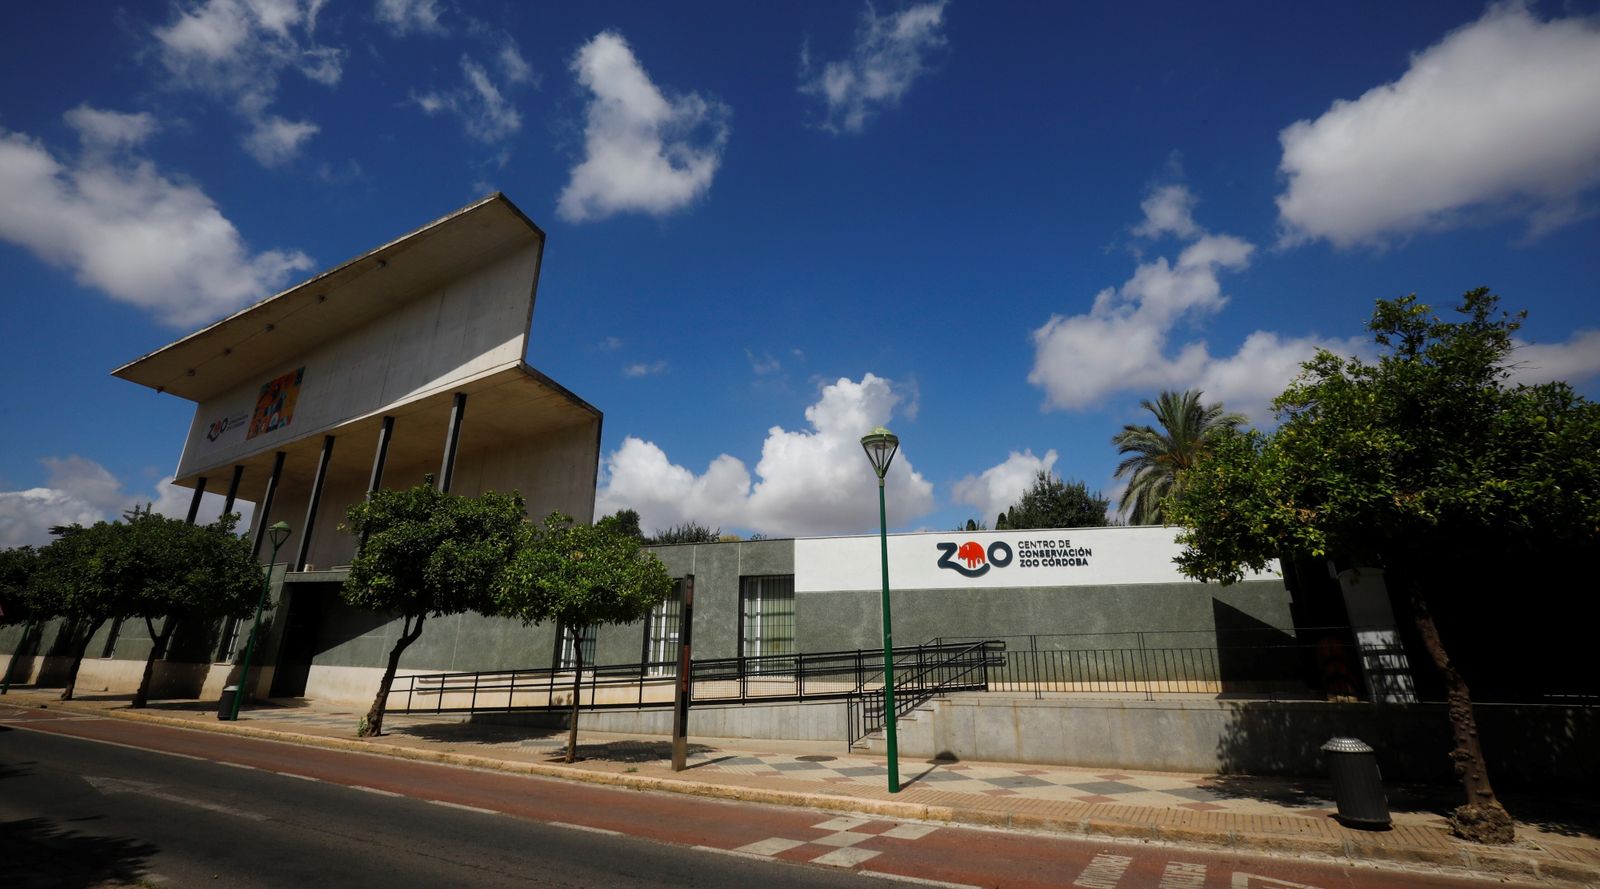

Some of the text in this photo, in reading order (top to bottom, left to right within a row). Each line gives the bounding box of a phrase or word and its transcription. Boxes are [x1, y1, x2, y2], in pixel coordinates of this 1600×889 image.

[1018, 540, 1071, 549] CENTRO DE
[1019, 547, 1092, 558] CONSERVACIÓN
[1020, 556, 1089, 567] ZOO CÓRDOBA
